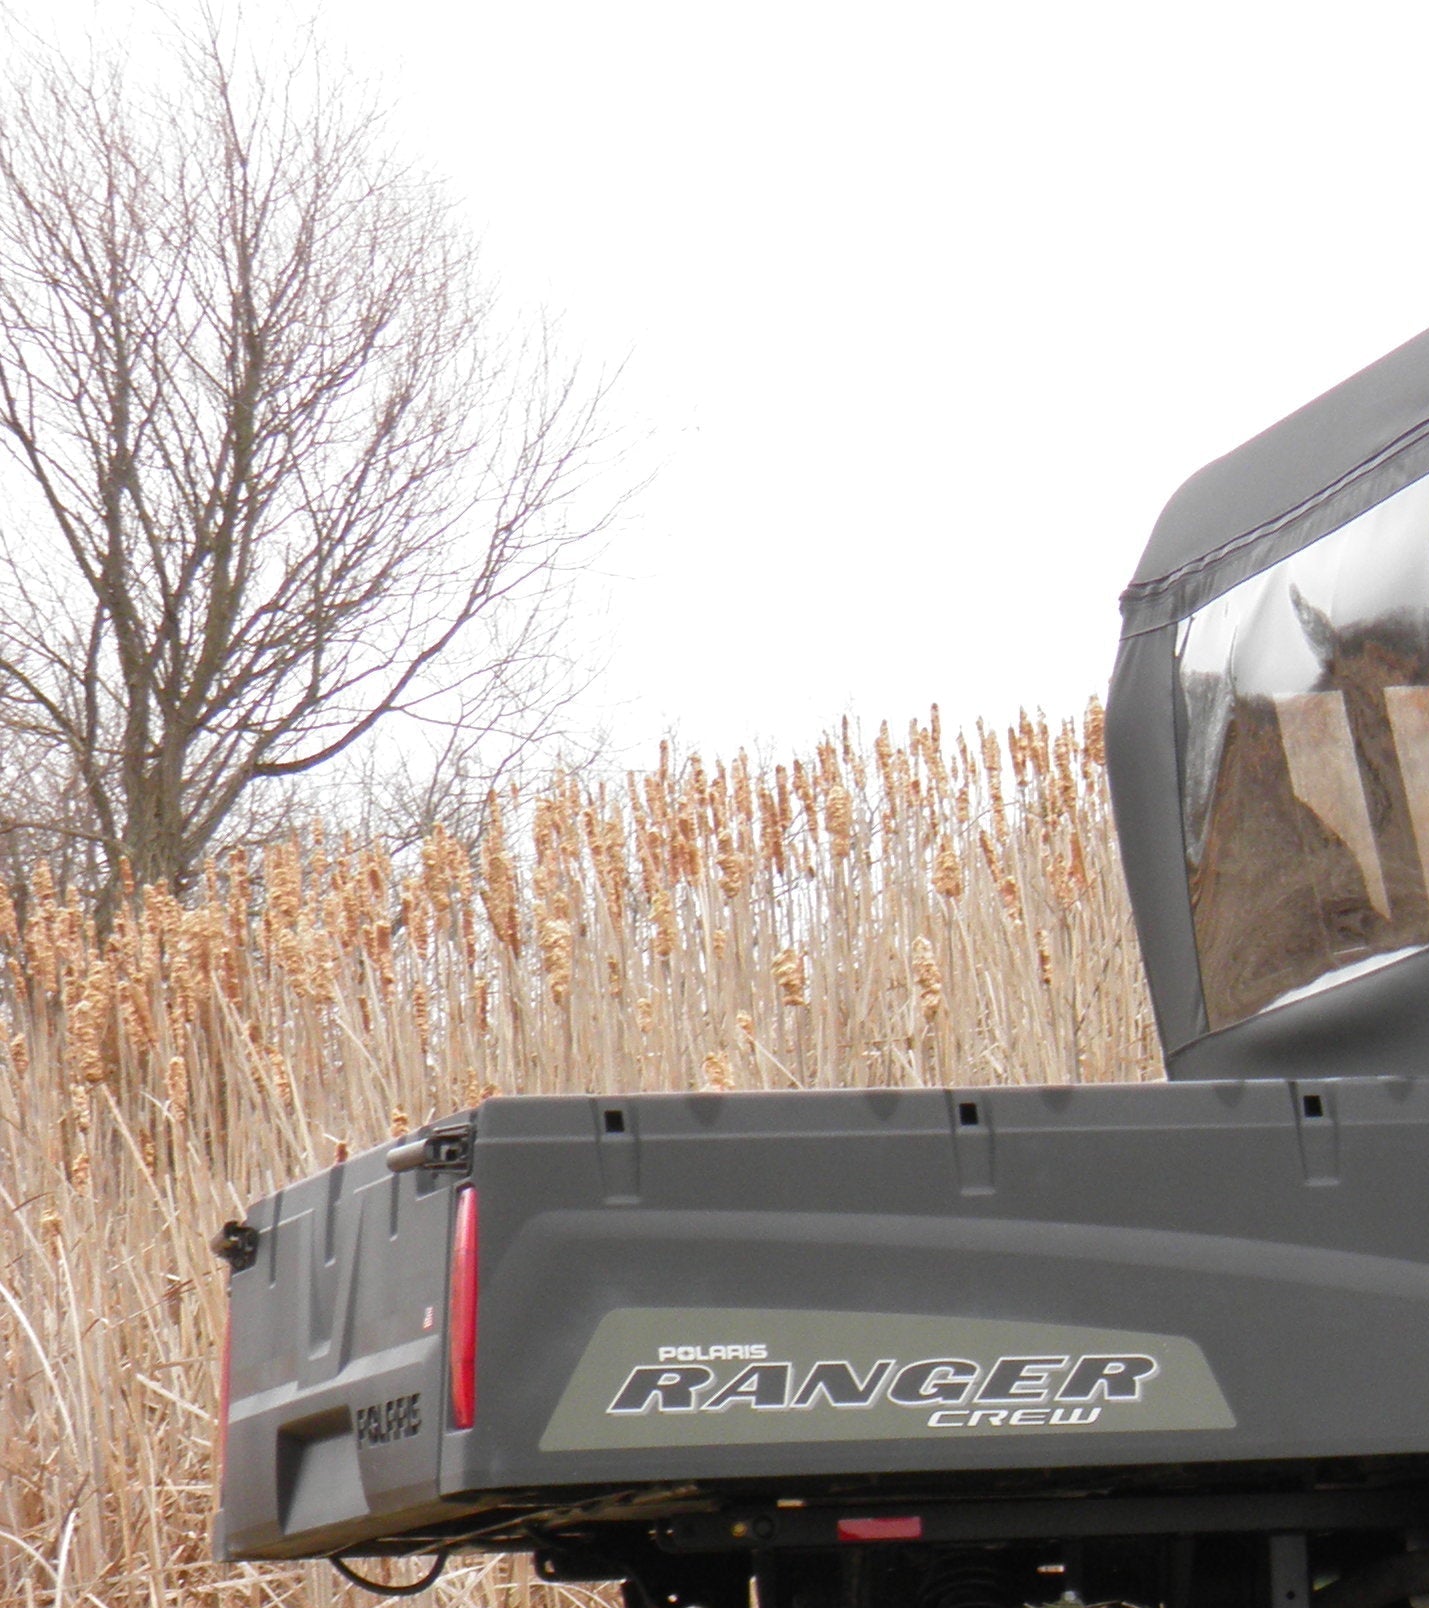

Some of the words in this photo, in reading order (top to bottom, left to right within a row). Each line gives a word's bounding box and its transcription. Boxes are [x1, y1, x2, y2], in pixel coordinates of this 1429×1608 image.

[658, 1344, 768, 1362] POLARIS
[606, 1354, 1160, 1416] RANGER
[927, 1407, 1102, 1427] CREW
